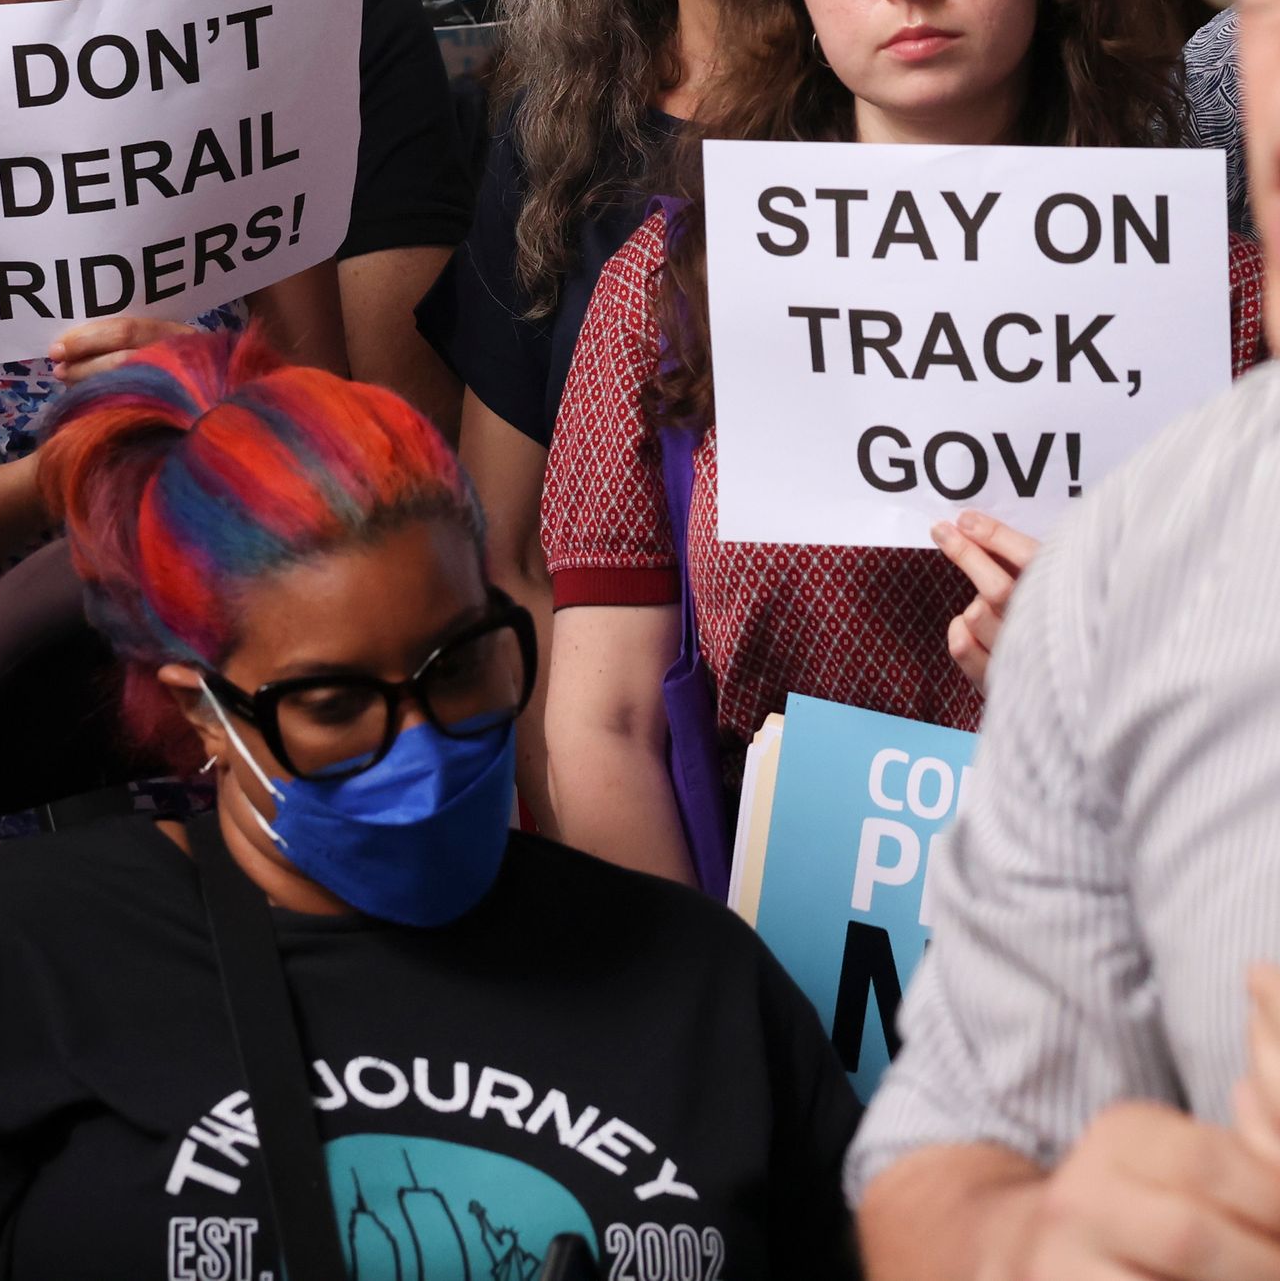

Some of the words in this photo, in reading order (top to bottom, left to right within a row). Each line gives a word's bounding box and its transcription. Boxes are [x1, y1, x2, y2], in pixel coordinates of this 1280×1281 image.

[12, 5, 273, 108] DON'T
[755, 186, 1001, 262] STAY
[1034, 192, 1170, 264] ON
[788, 306, 1142, 398] TRACK,
[856, 426, 1083, 501] GOV!
[312, 1055, 699, 1201] JOURNEY
